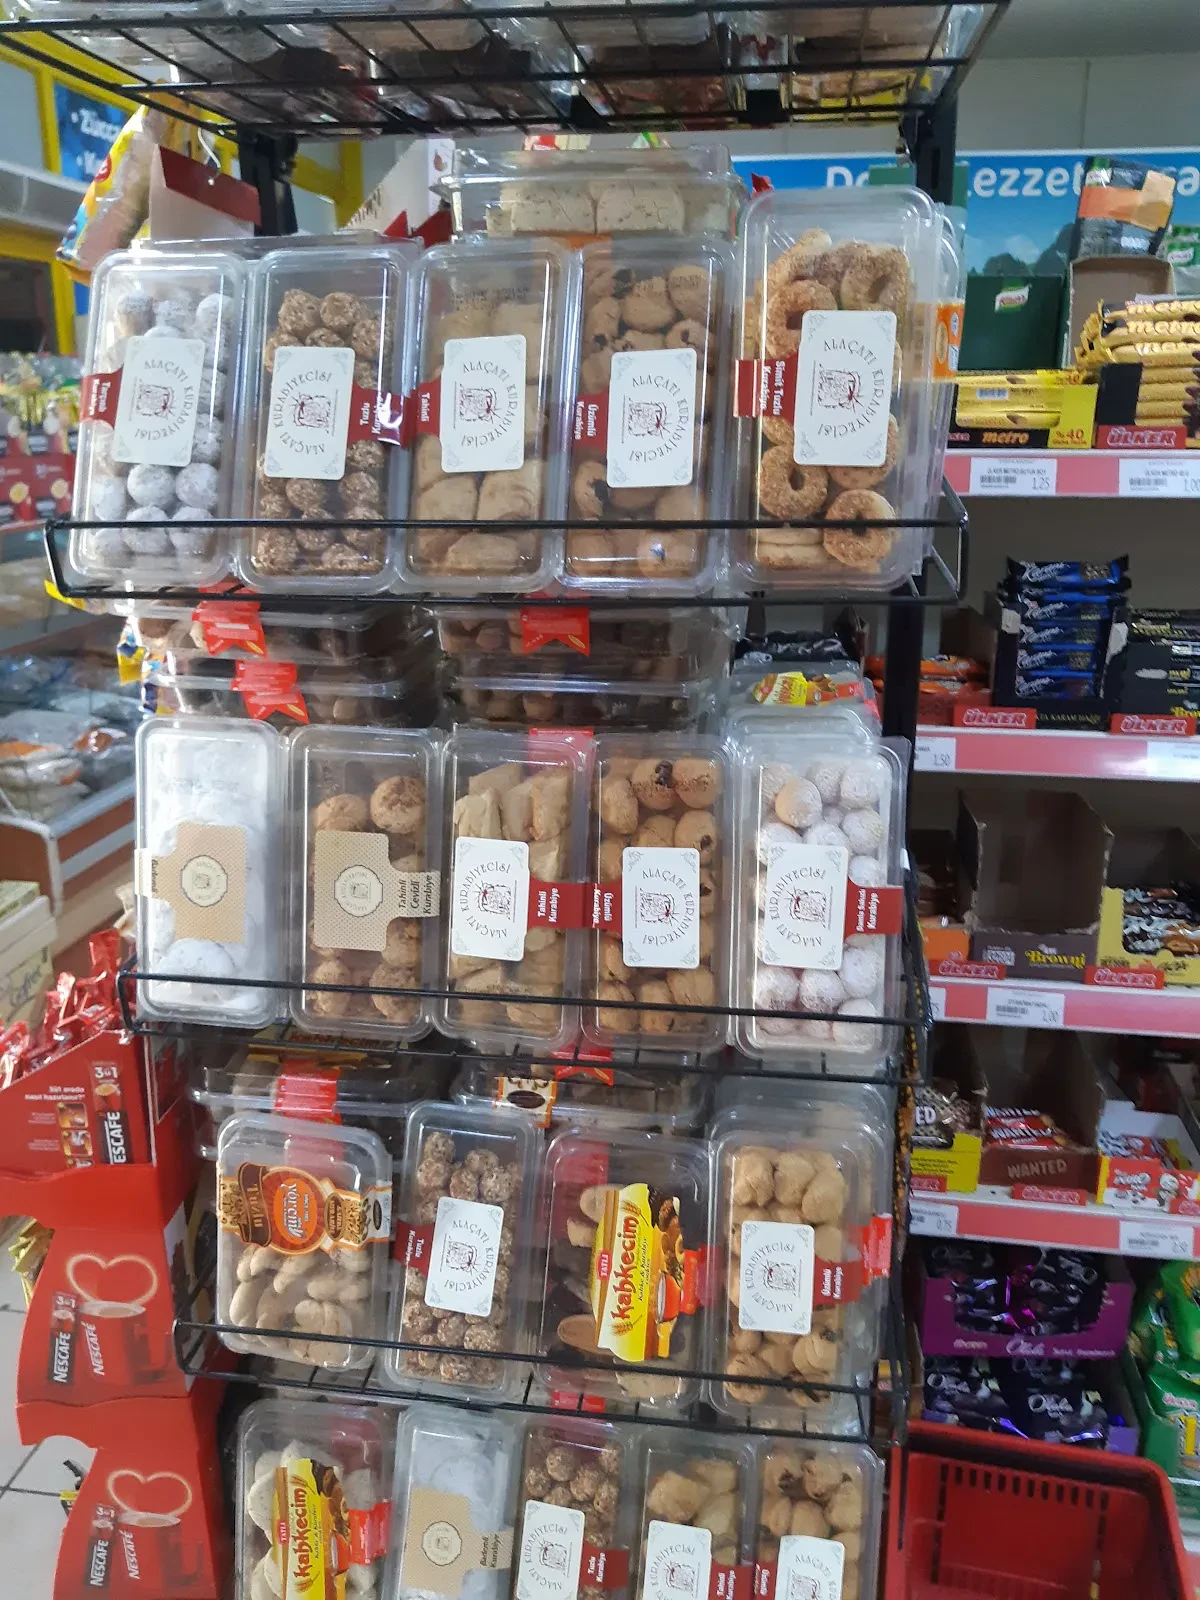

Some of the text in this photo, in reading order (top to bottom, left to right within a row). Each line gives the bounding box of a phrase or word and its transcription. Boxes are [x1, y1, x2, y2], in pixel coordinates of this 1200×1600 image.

[772, 386, 785, 416] Tuzlu
[360, 402, 371, 426] Tuzlu
[1106, 427, 1177, 447] ÜLKER
[642, 868, 686, 890] ALAÇATI
[399, 880, 407, 909] Tahinli
[423, 875, 436, 914] Kurabiye
[538, 891, 547, 917] Tahinli
[549, 888, 560, 922] Kurabiye
[867, 892, 880, 929] Kurabiye
[466, 916, 508, 939] ALAÇATI
[776, 923, 822, 947] ALAÇATI
[106, 1111, 126, 1164] ESCAFE
[1008, 1158, 1067, 1179] WANTED
[601, 1254, 609, 1277] TATLI
